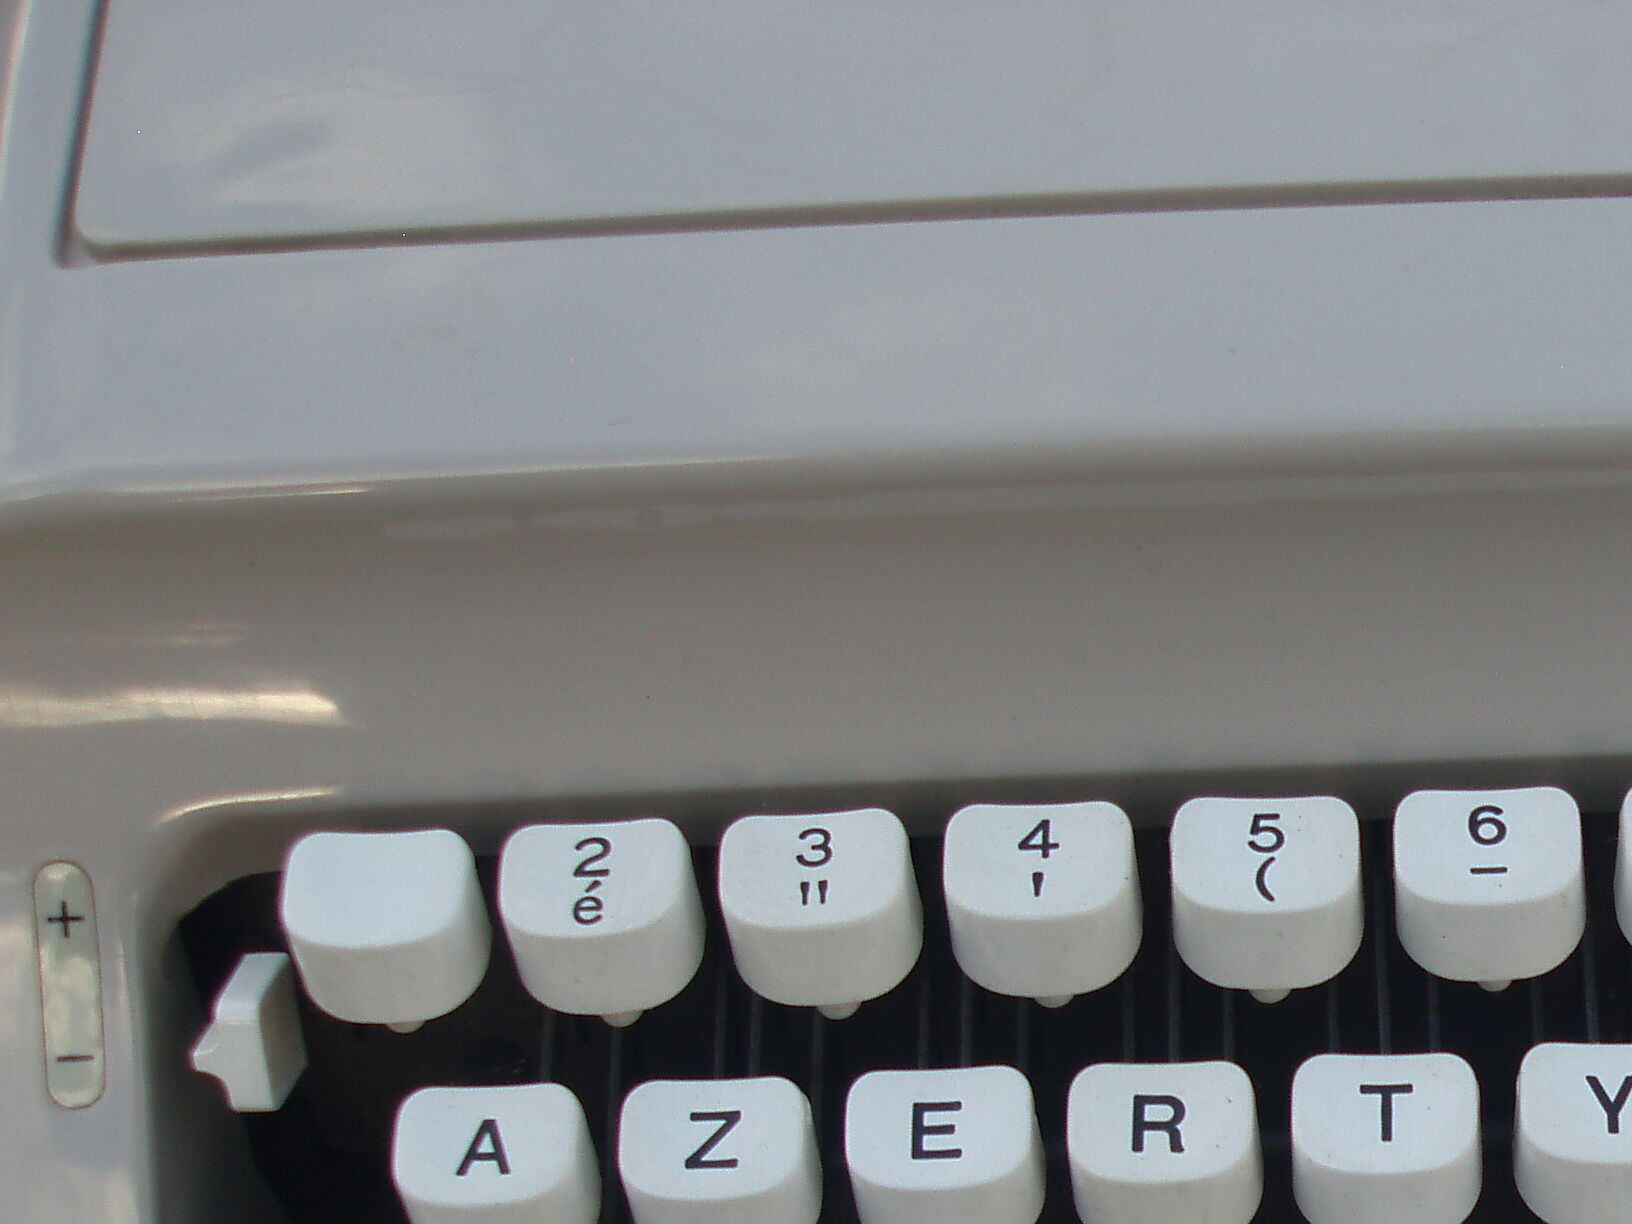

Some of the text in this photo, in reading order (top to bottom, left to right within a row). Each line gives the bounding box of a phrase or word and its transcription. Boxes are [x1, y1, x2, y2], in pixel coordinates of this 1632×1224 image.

[795, 828, 833, 868] 3
[1017, 818, 1060, 859] 4
[1247, 813, 1285, 853] 5
[1468, 805, 1507, 846] 6
[572, 836, 611, 878] 2
[1255, 856, 1276, 902] (
[572, 879, 603, 925] é
[911, 1100, 963, 1160] E
[1131, 1094, 1186, 1154] R
[1359, 1083, 1414, 1142] T
[455, 1118, 510, 1177] A
[684, 1110, 741, 1170] Z
